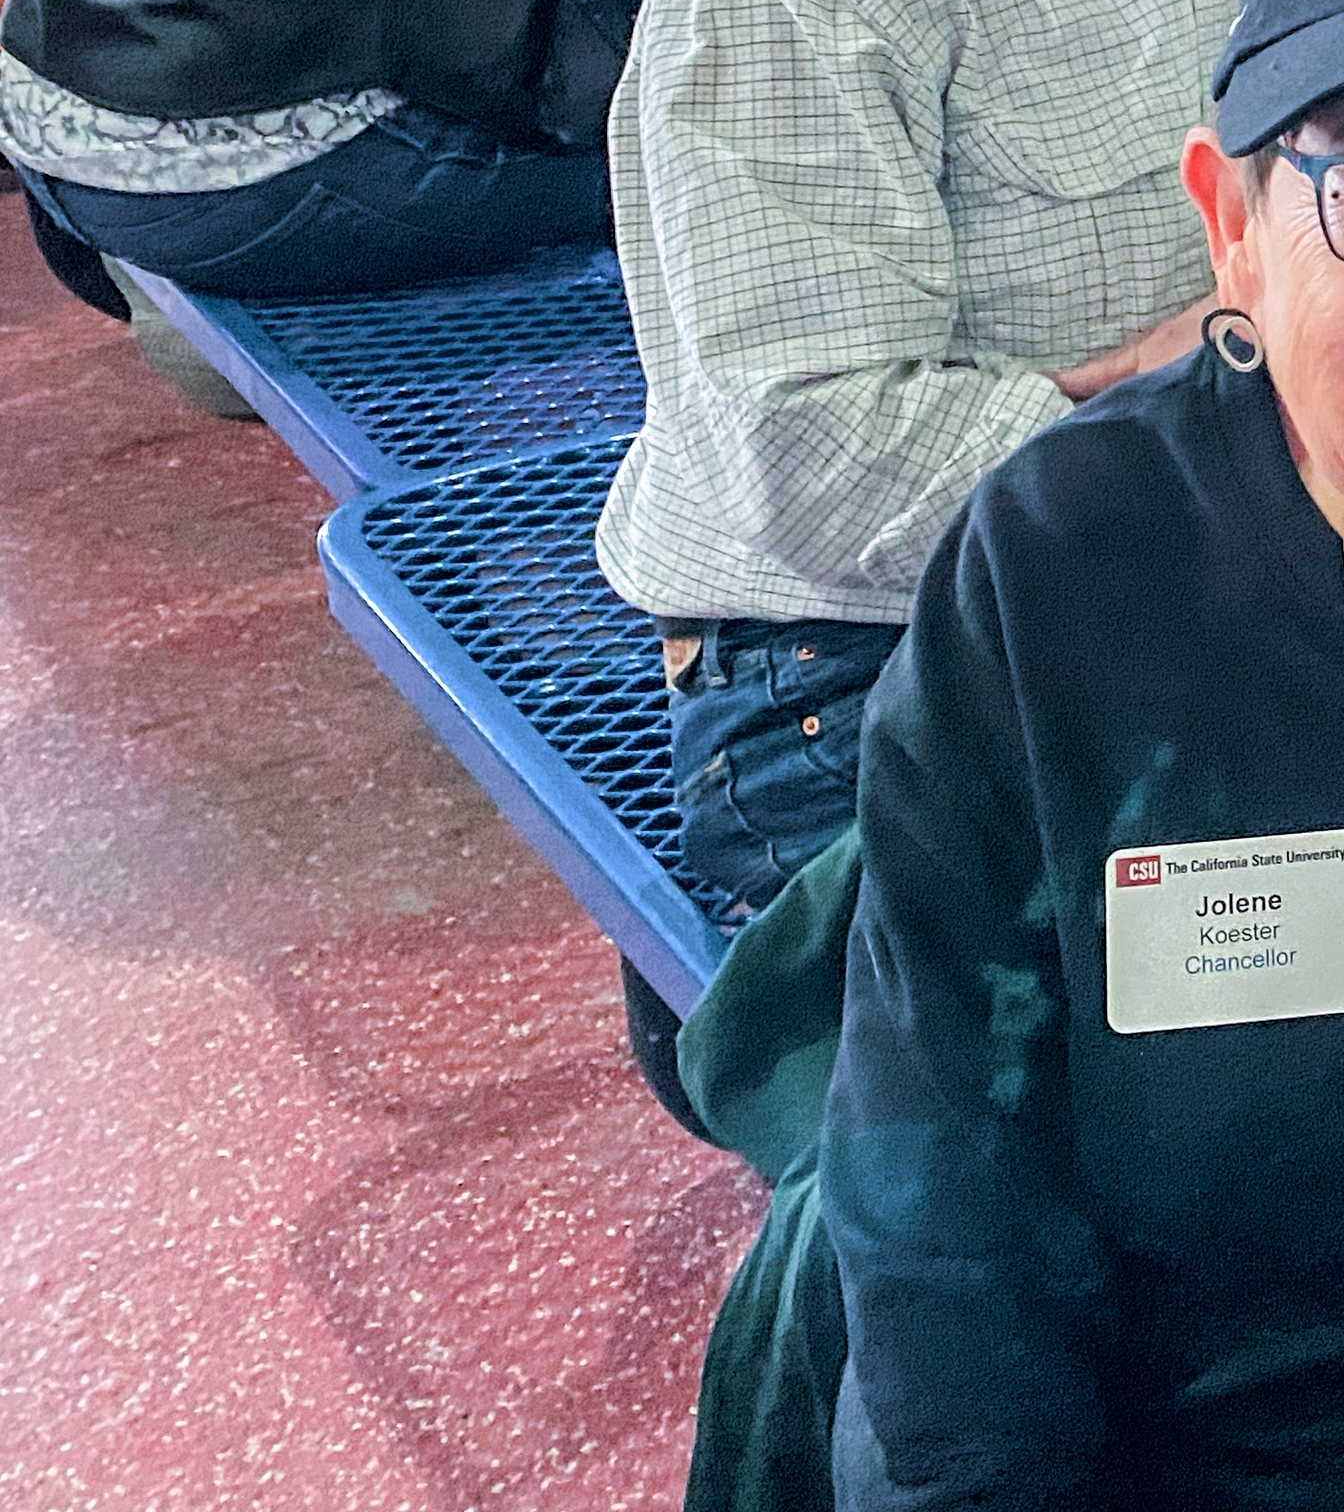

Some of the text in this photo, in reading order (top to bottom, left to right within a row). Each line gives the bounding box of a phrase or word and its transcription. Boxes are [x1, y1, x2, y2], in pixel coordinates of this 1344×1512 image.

[1128, 861, 1159, 881] CSU
[1166, 862, 1188, 875] The
[1191, 858, 1248, 873] California
[1252, 854, 1282, 867] State
[1195, 893, 1283, 918] Jolene
[1200, 923, 1281, 947] Koester
[1185, 949, 1298, 975] Chancellor
